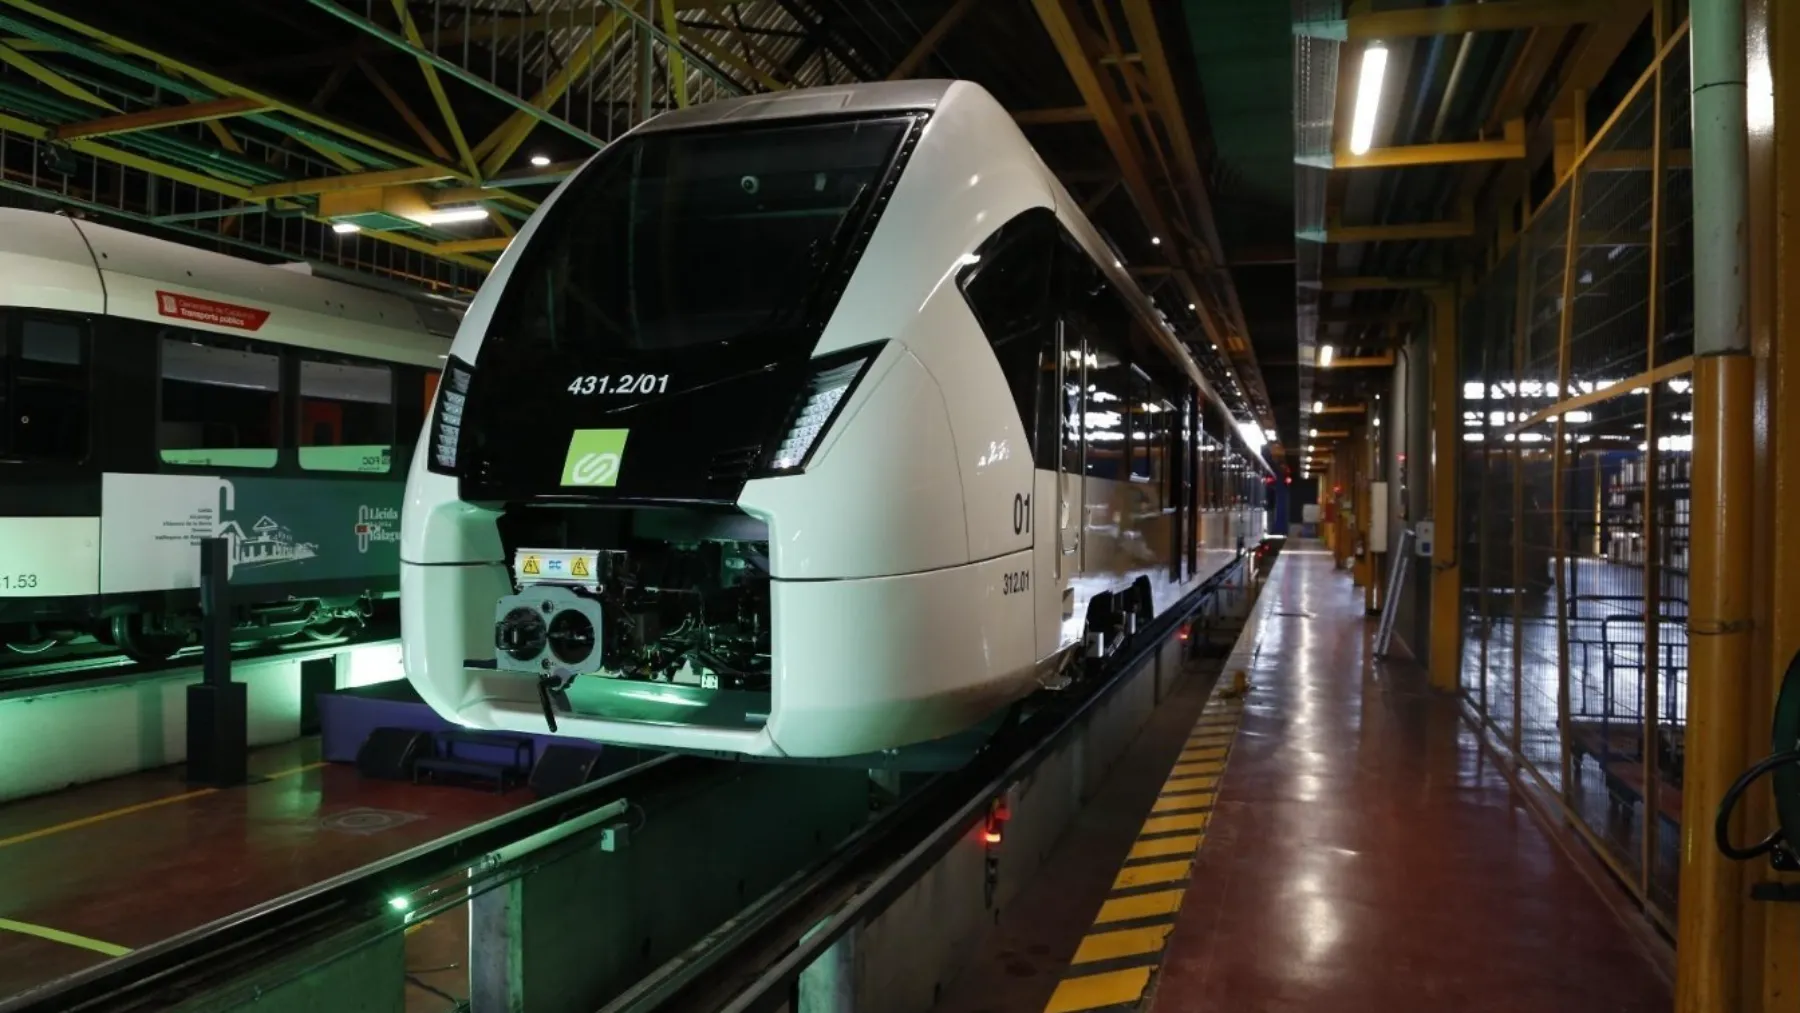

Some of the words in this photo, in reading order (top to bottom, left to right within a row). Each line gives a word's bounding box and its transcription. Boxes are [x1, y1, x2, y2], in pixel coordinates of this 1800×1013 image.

[567, 373, 669, 395] 431.2/01
[1013, 493, 1030, 535] 01
[0, 574, 37, 589] 1.53
[1003, 570, 1030, 596] 312.01
